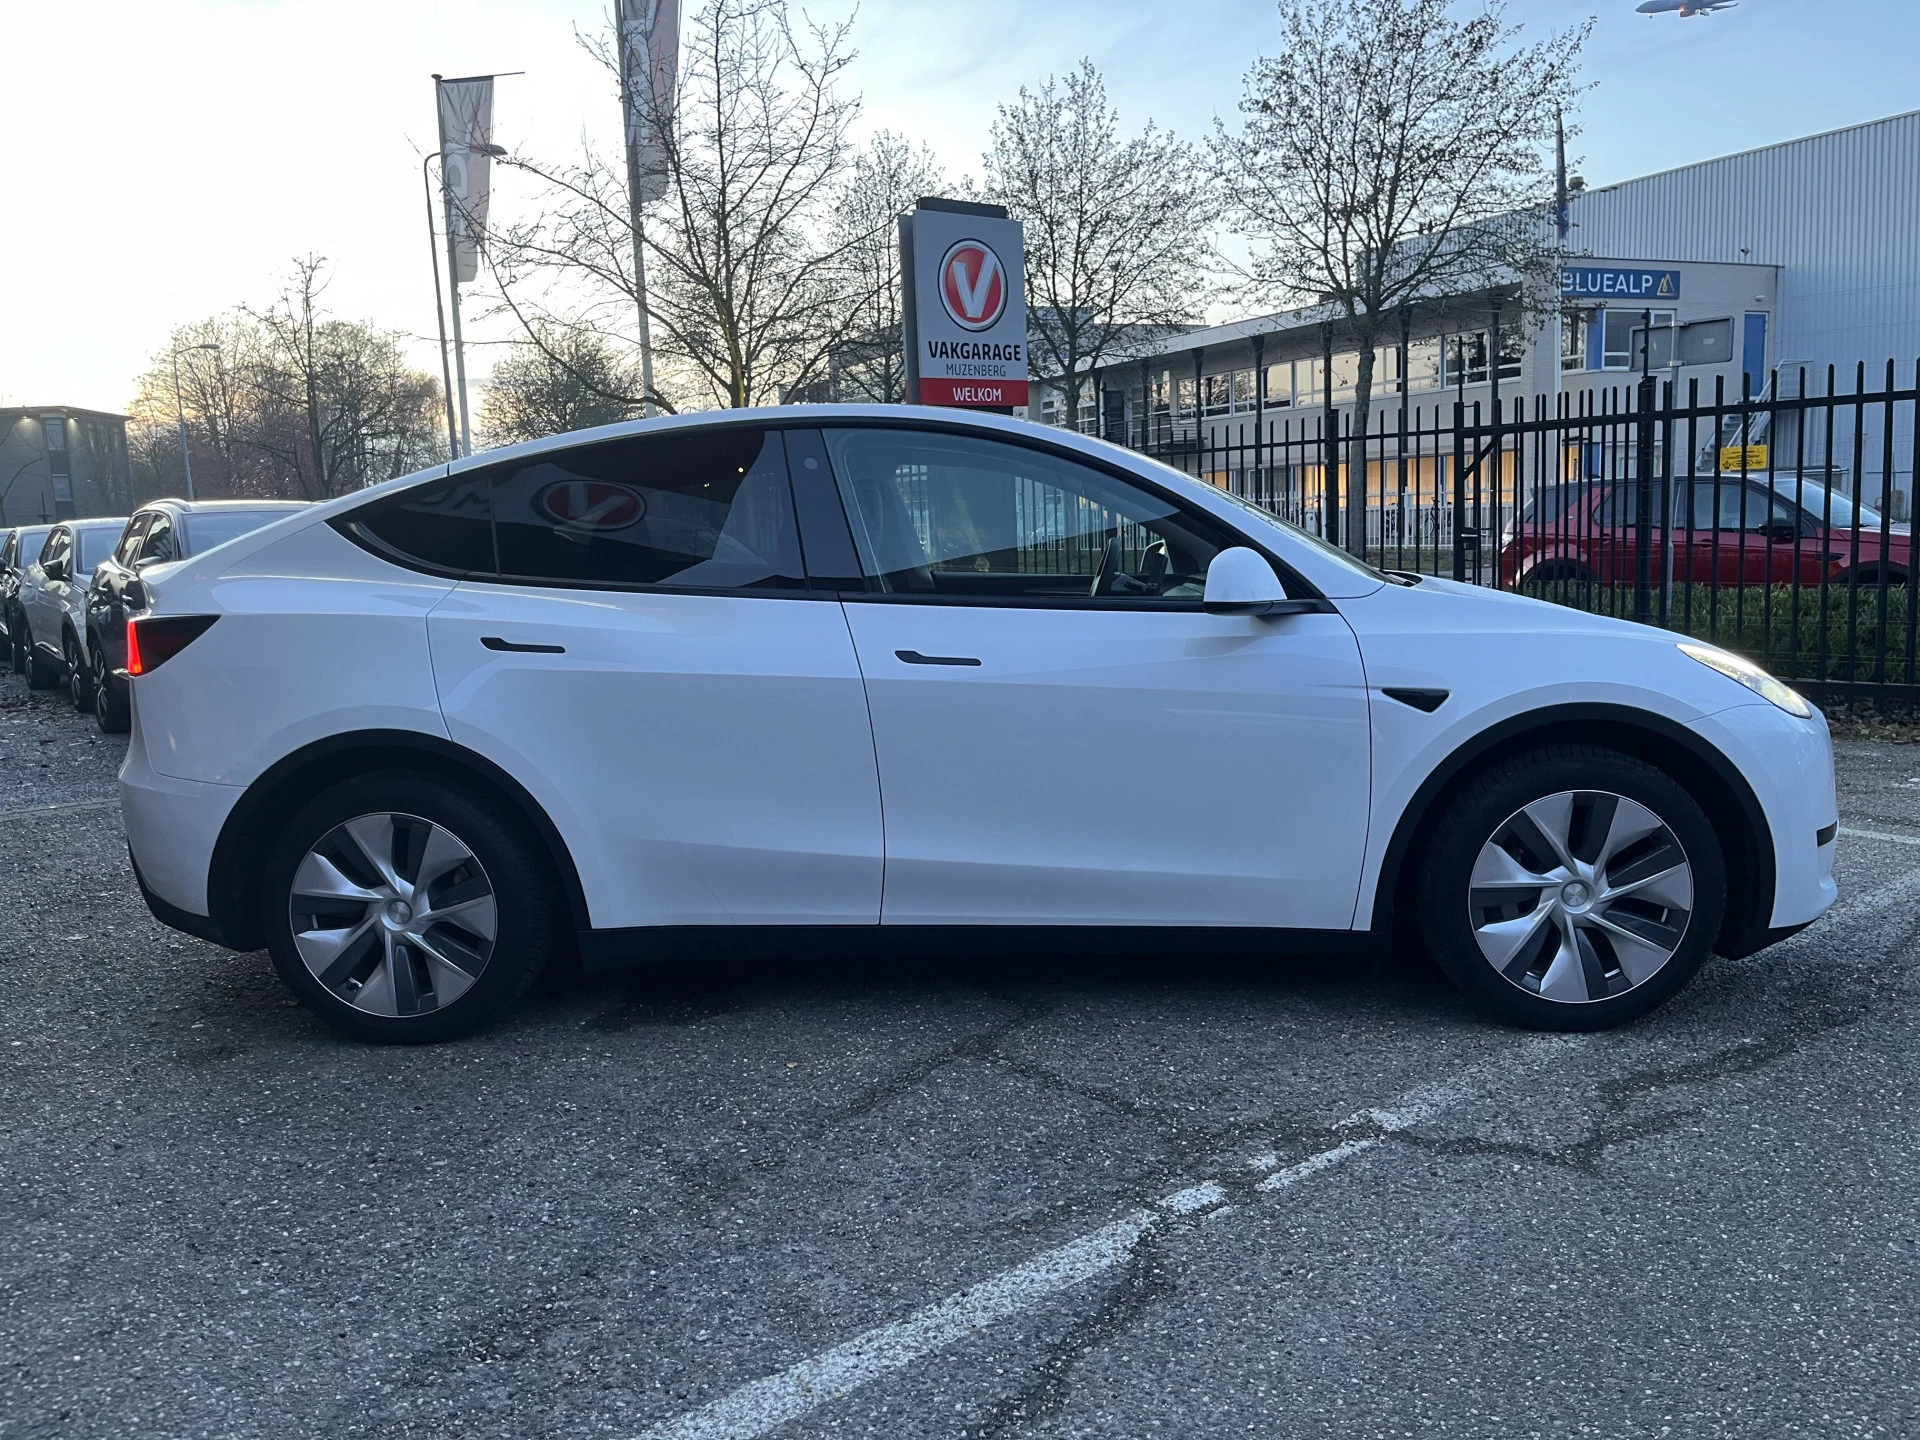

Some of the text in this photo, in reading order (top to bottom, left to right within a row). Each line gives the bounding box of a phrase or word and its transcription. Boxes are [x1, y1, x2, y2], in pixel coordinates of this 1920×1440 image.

[954, 250, 996, 318] V
[1562, 272, 1653, 294] BLUEALP
[928, 341, 1021, 361] VAKGARAGE
[946, 363, 1006, 377] MUZENBERG
[953, 387, 1002, 402] WELKOM
